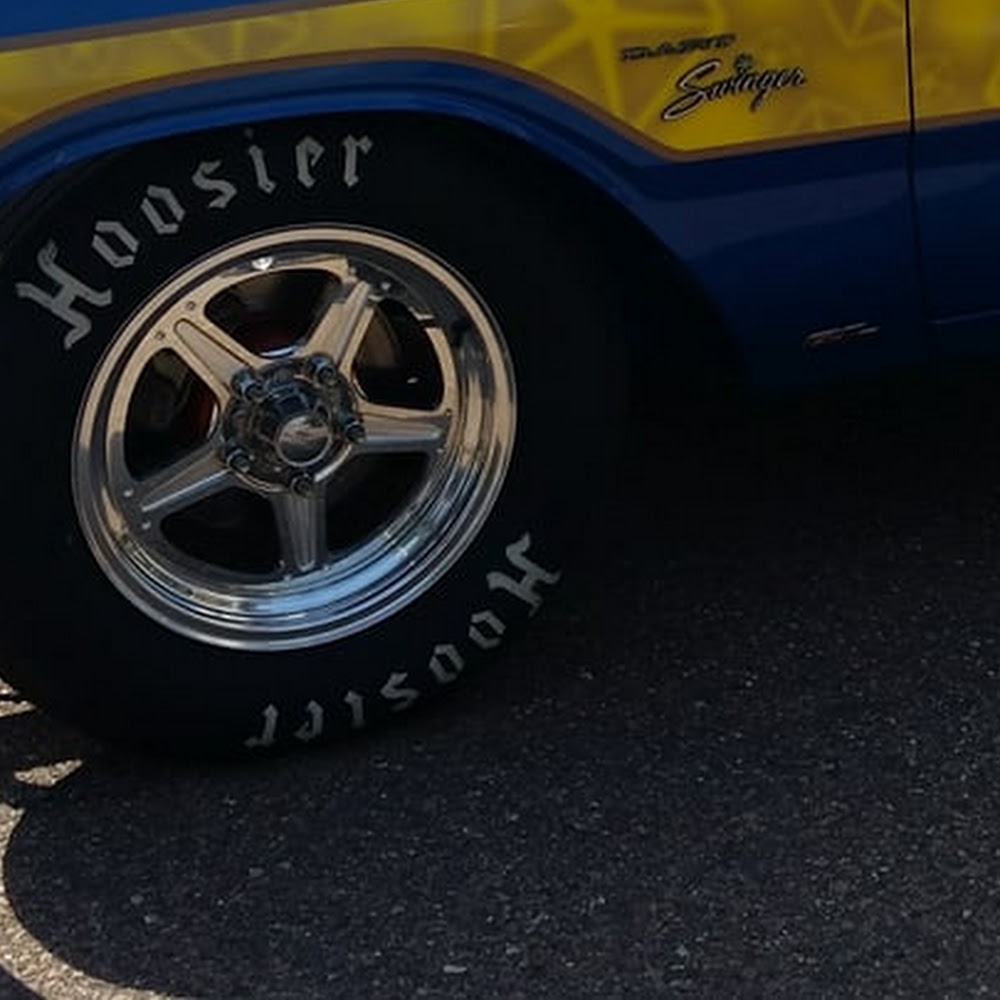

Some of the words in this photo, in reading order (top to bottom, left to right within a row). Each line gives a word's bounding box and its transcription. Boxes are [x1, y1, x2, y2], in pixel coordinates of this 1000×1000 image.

[661, 52, 807, 122] Swinger
[16, 127, 375, 351] Hoosier
[244, 532, 562, 748] Hoosier
